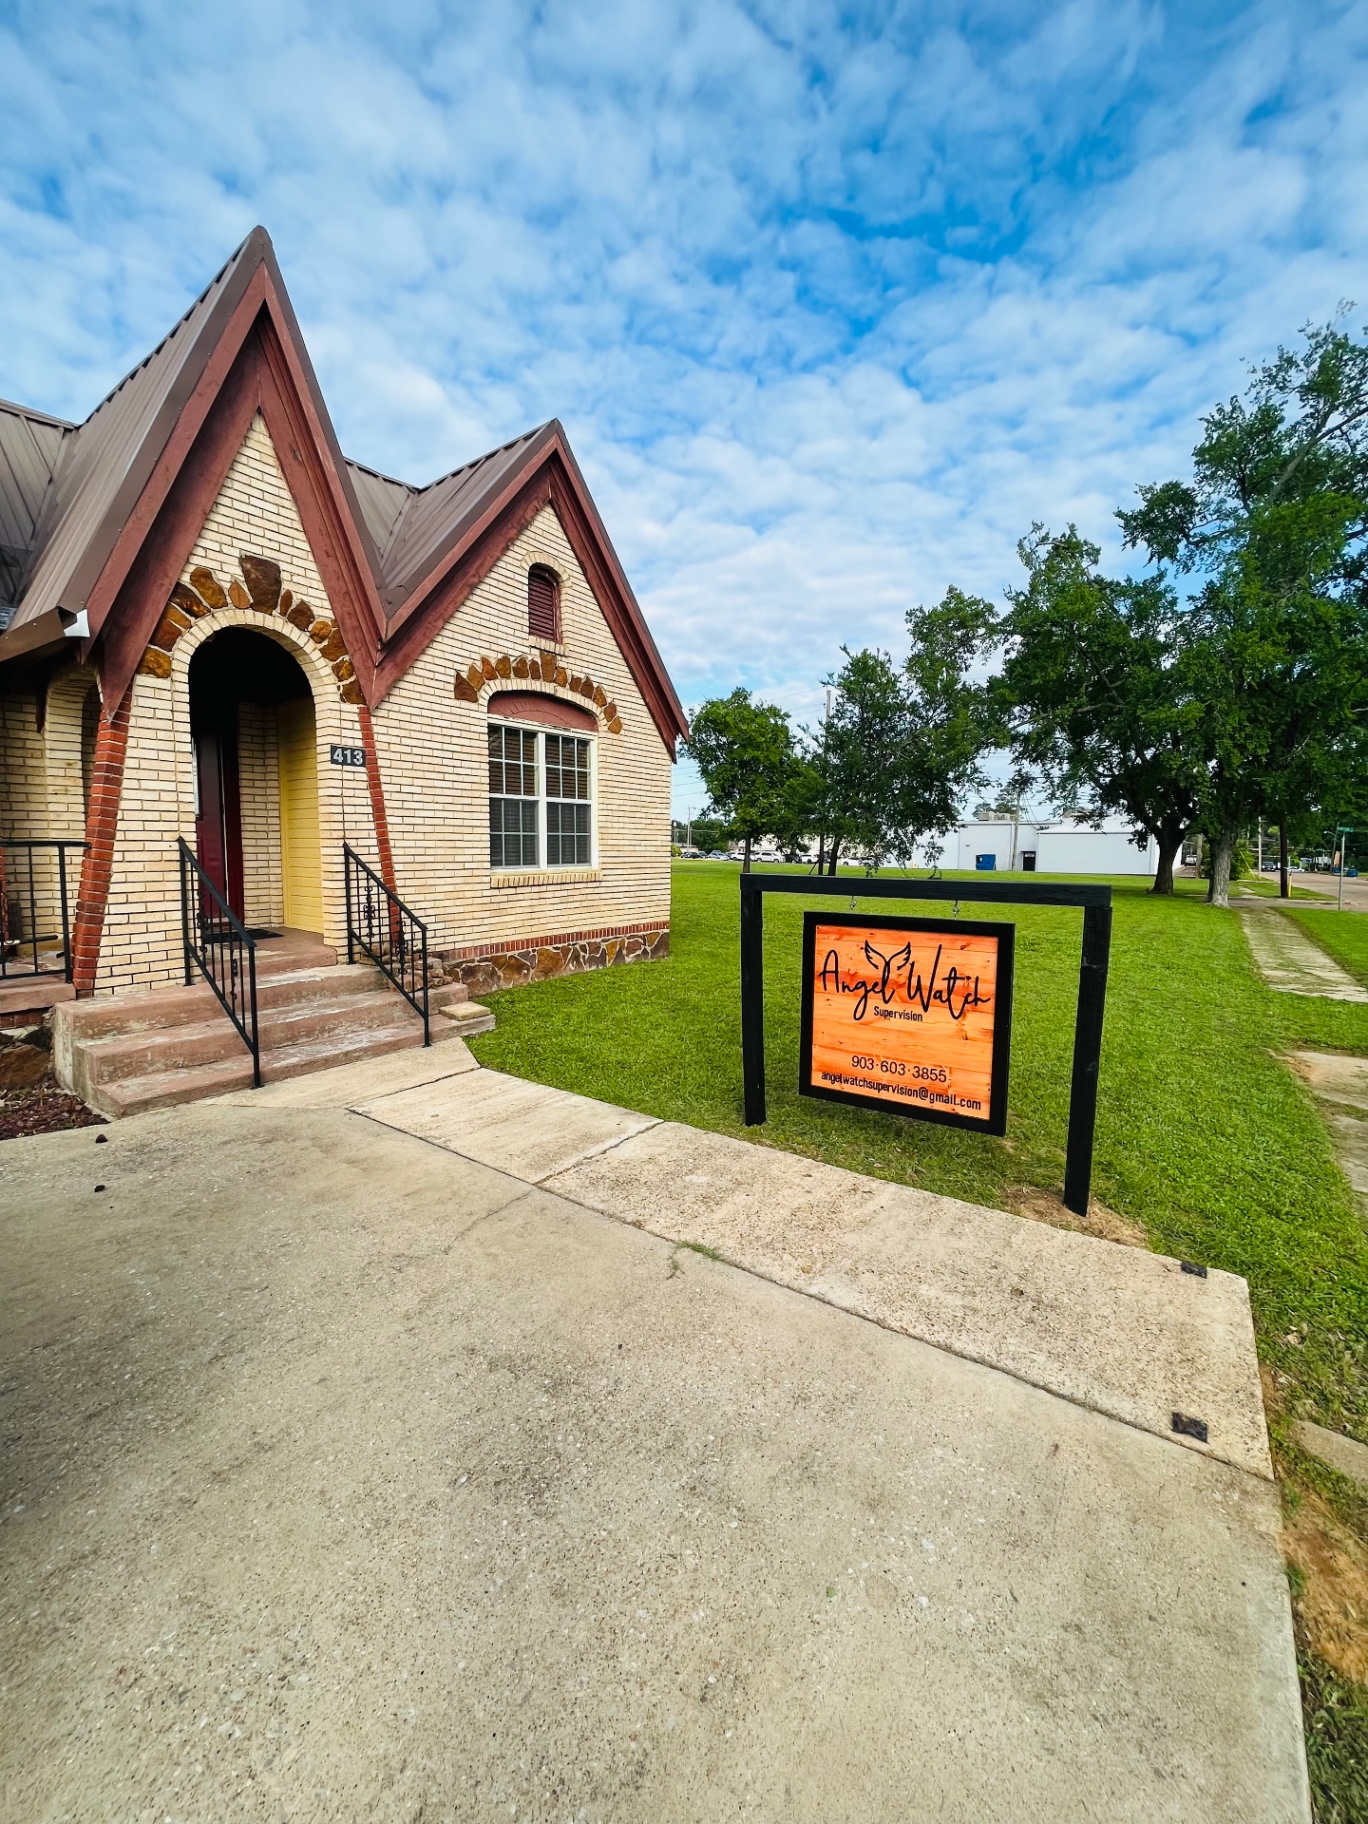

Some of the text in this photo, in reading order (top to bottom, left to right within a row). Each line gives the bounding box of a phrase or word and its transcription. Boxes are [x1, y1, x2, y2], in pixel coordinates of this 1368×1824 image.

[333, 748, 363, 765] 413
[818, 944, 991, 1021] Angel Watch
[873, 1005, 923, 1022] Supervision
[821, 1071, 982, 1111] angelwatchsupervision@gmail.com
